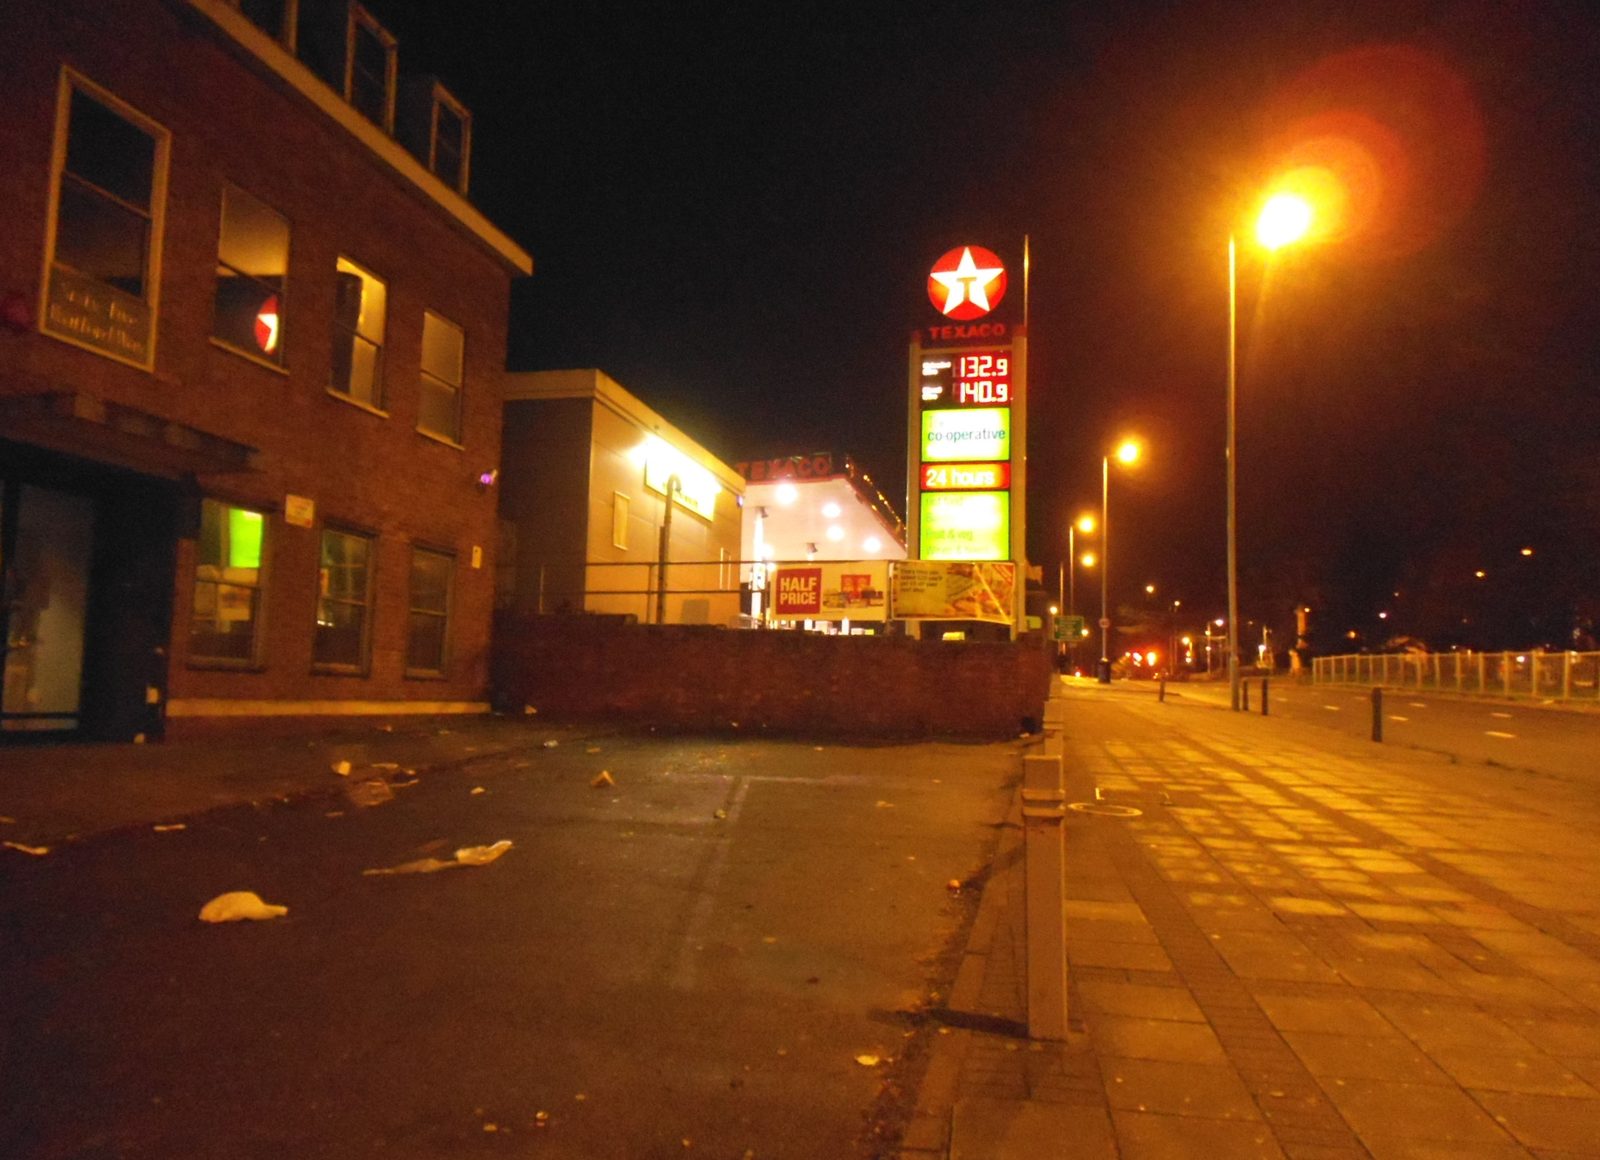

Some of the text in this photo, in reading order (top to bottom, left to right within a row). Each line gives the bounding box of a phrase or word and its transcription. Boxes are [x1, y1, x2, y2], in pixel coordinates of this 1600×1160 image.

[929, 323, 1006, 340] TEXACO
[960, 355, 1008, 378] 132.9
[960, 381, 1008, 403] 140.9
[736, 455, 830, 480] TEXACO
[925, 468, 995, 487] 24 hours
[780, 576, 817, 592] HALF
[779, 591, 817, 605] PRICE
